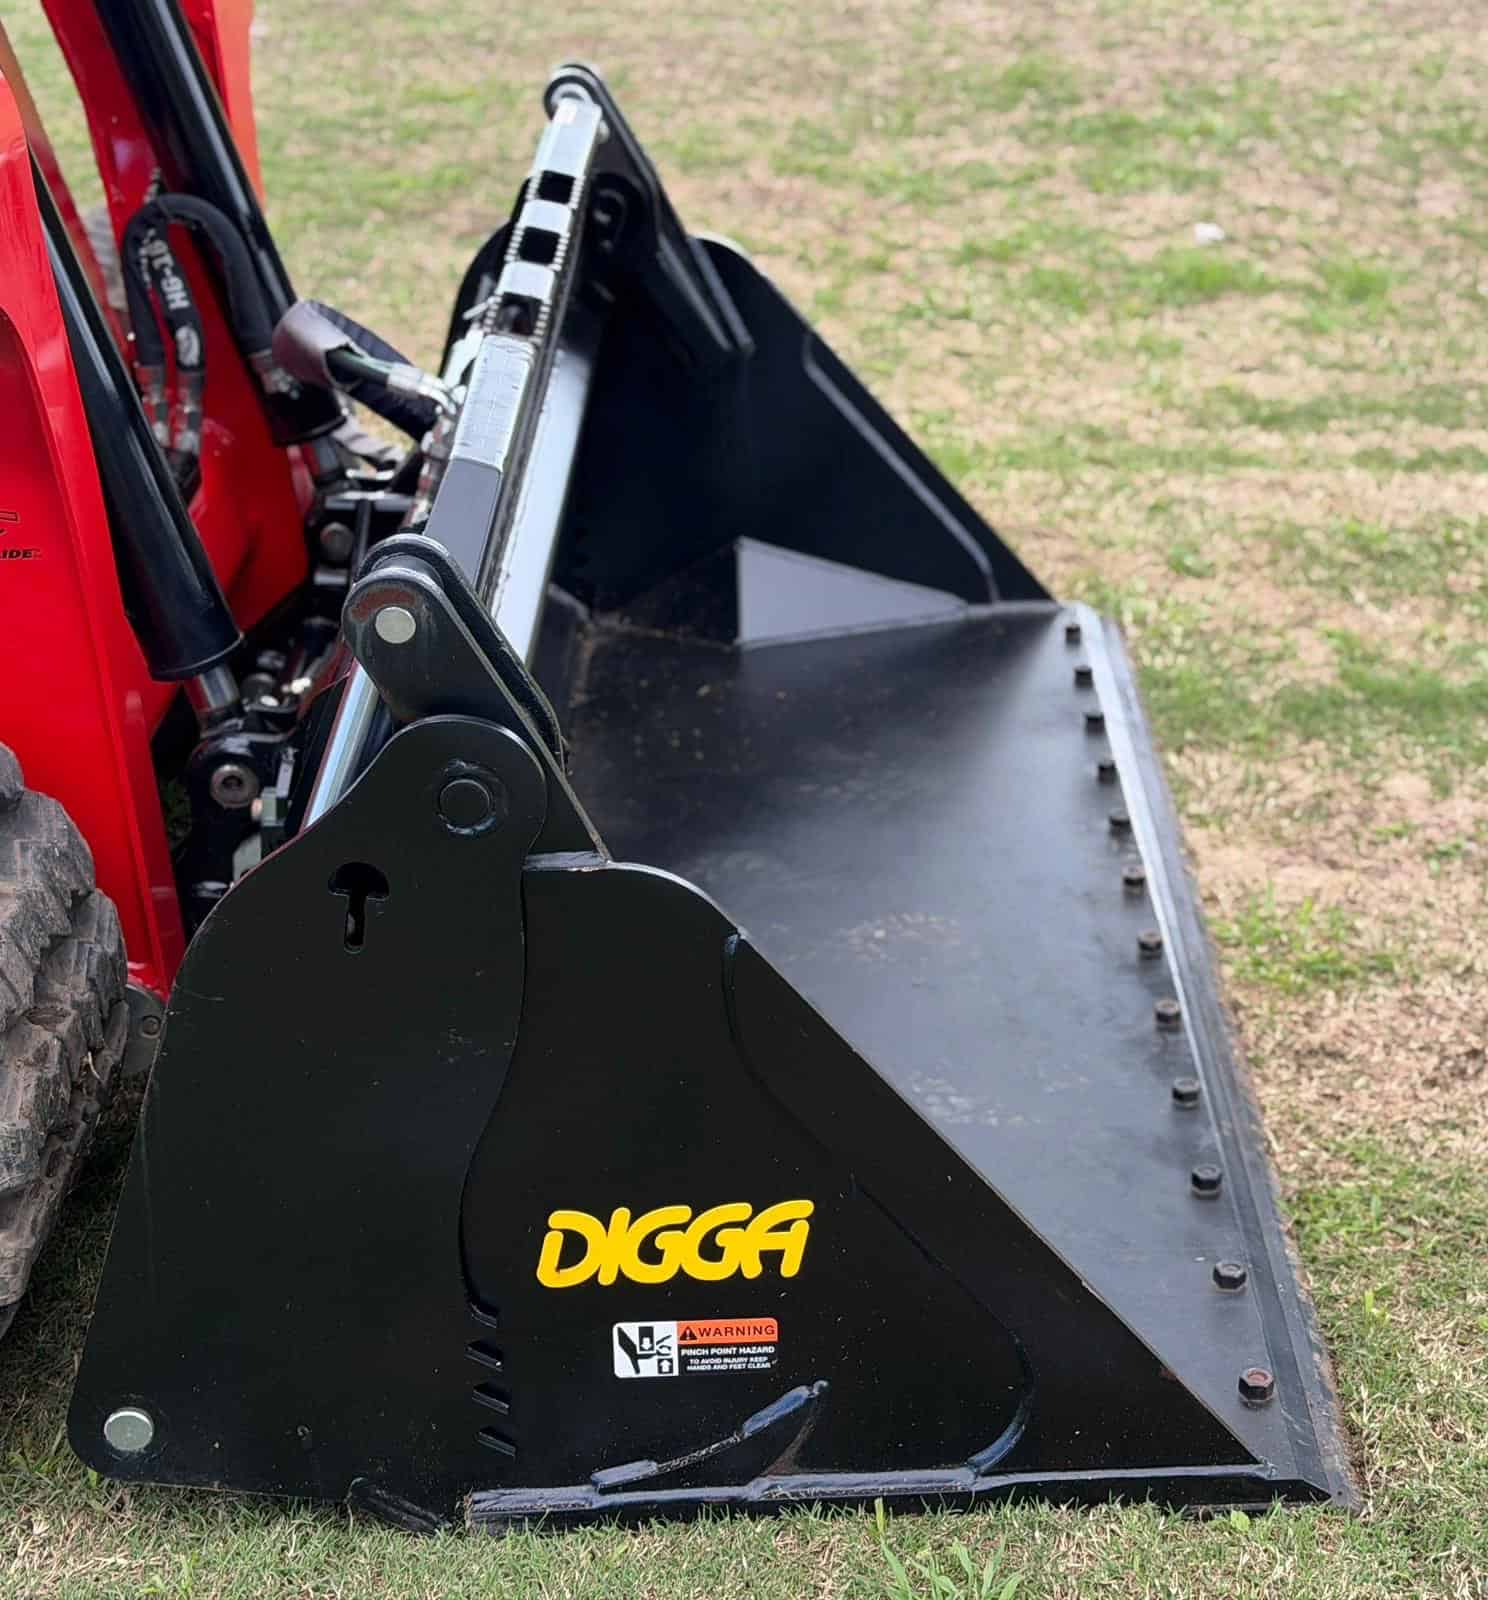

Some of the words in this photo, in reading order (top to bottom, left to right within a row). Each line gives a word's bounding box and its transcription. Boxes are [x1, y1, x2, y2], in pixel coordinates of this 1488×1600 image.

[0, 549, 33, 559] IDE
[536, 1199, 815, 1288] DIGGA
[698, 1325, 775, 1337] WARNING
[681, 1348, 709, 1356] PINCH
[710, 1347, 737, 1355] POINT
[739, 1345, 775, 1354] HAZARD
